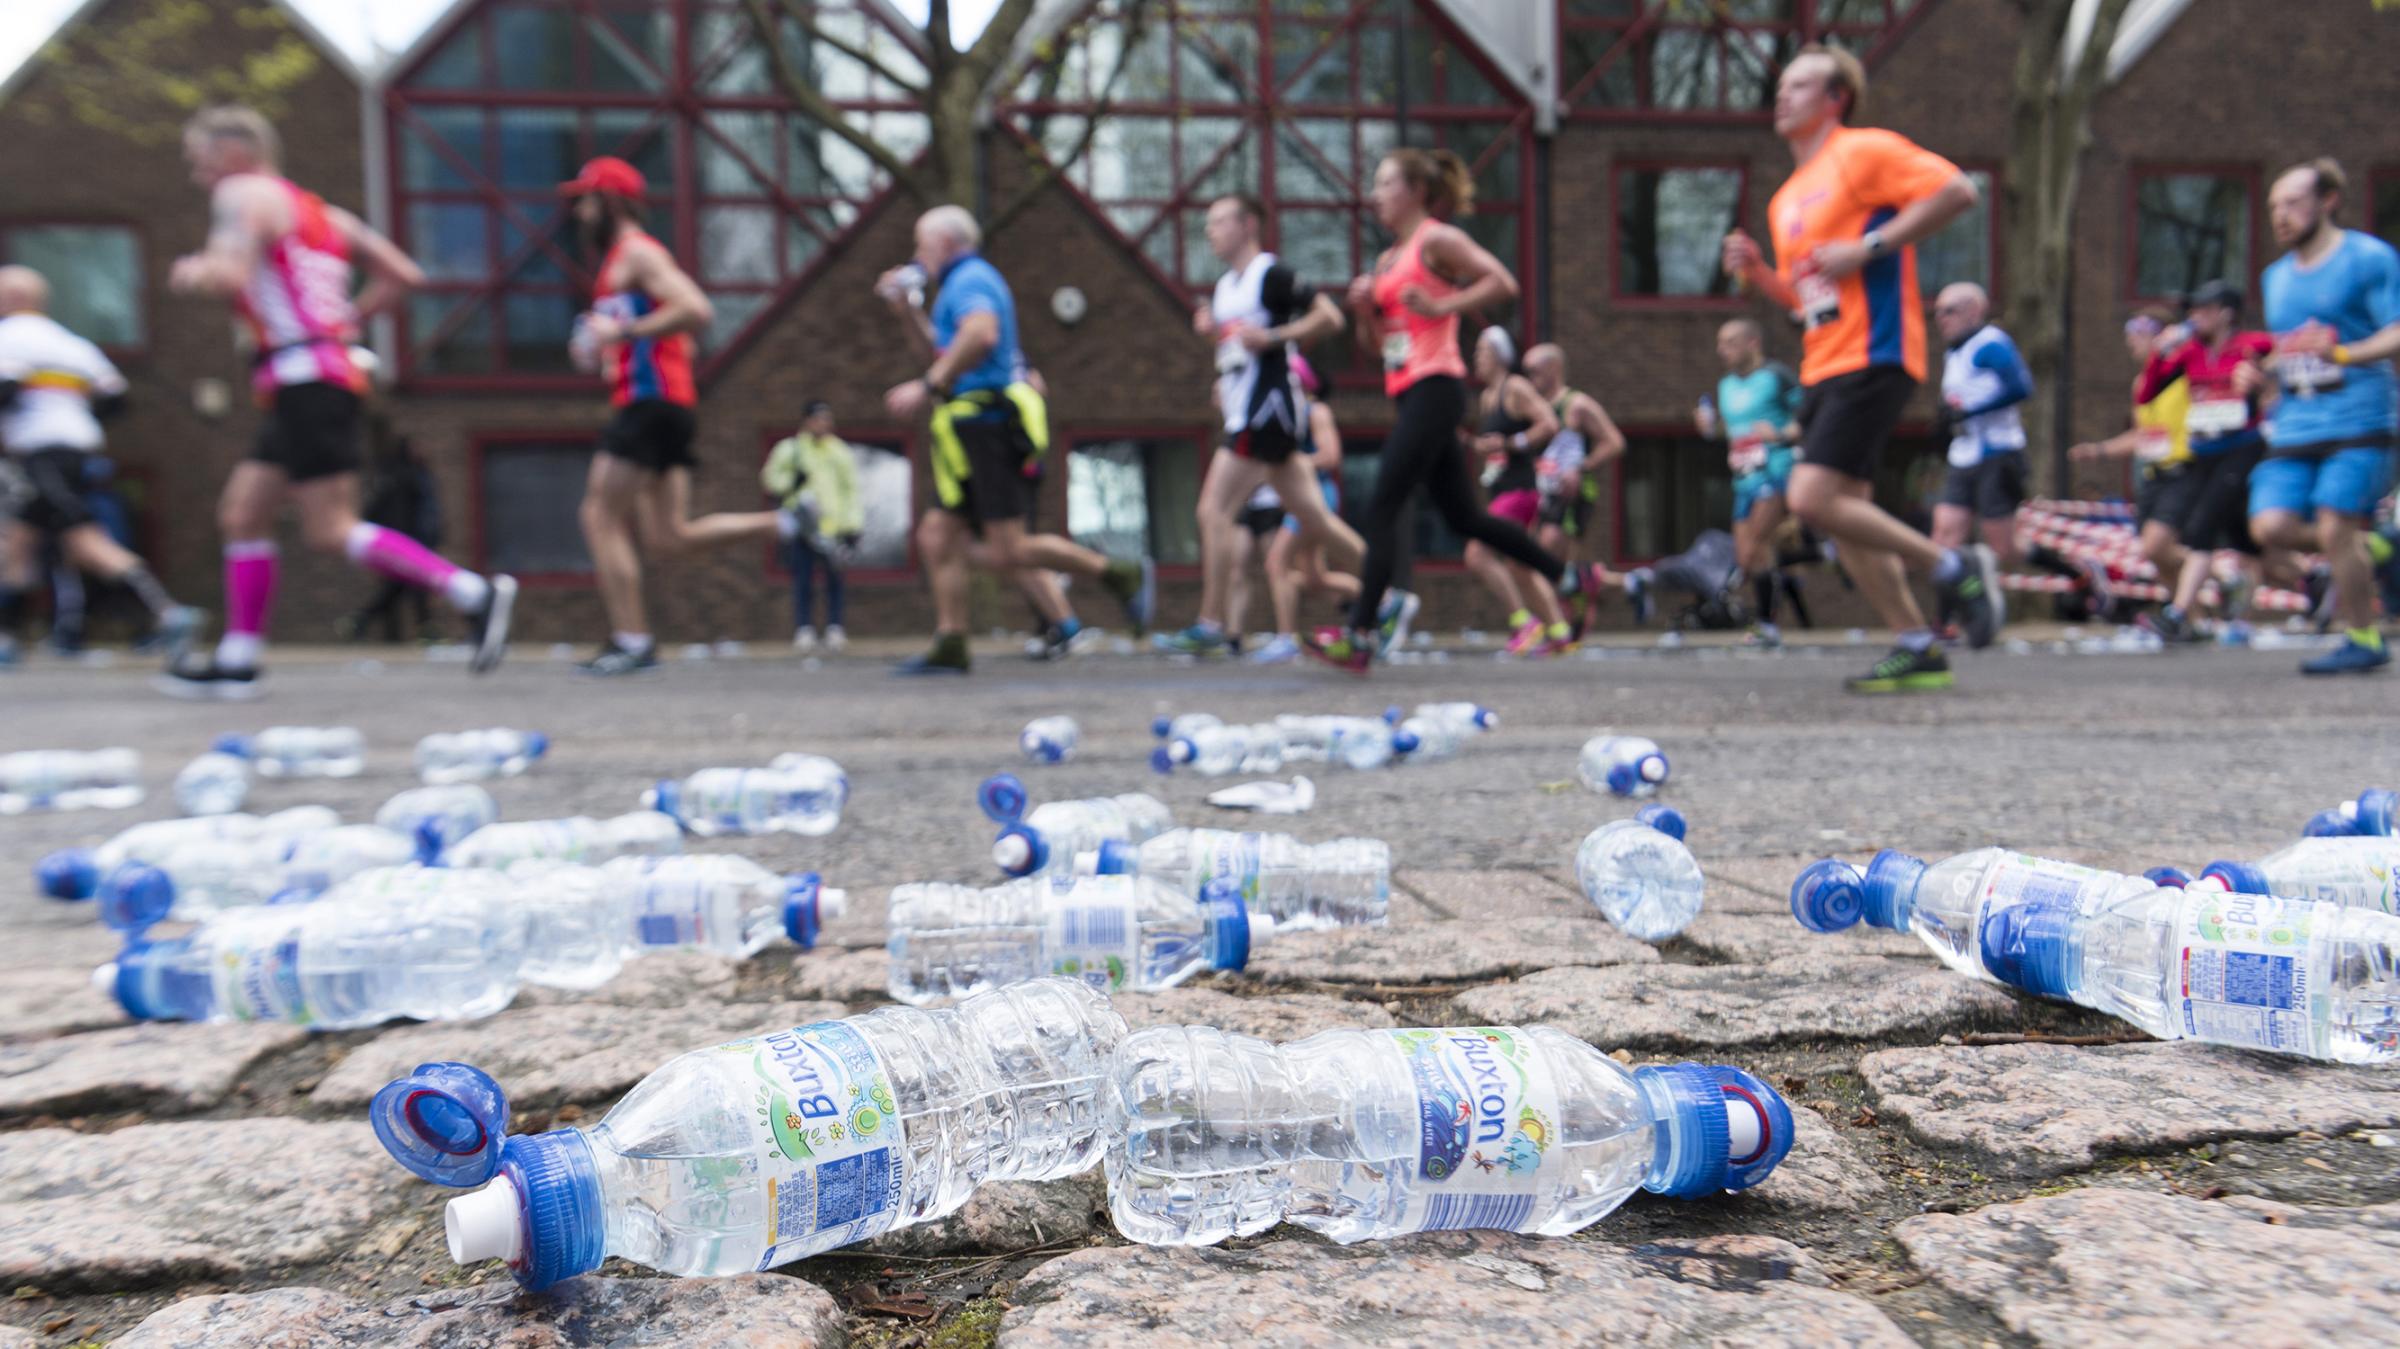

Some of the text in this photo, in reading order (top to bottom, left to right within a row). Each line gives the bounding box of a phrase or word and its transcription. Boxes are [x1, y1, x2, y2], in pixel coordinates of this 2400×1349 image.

[766, 1033, 839, 1119] Buxton
[1449, 1037, 1508, 1143] Buxton
[1424, 1120, 1434, 1147] WATER
